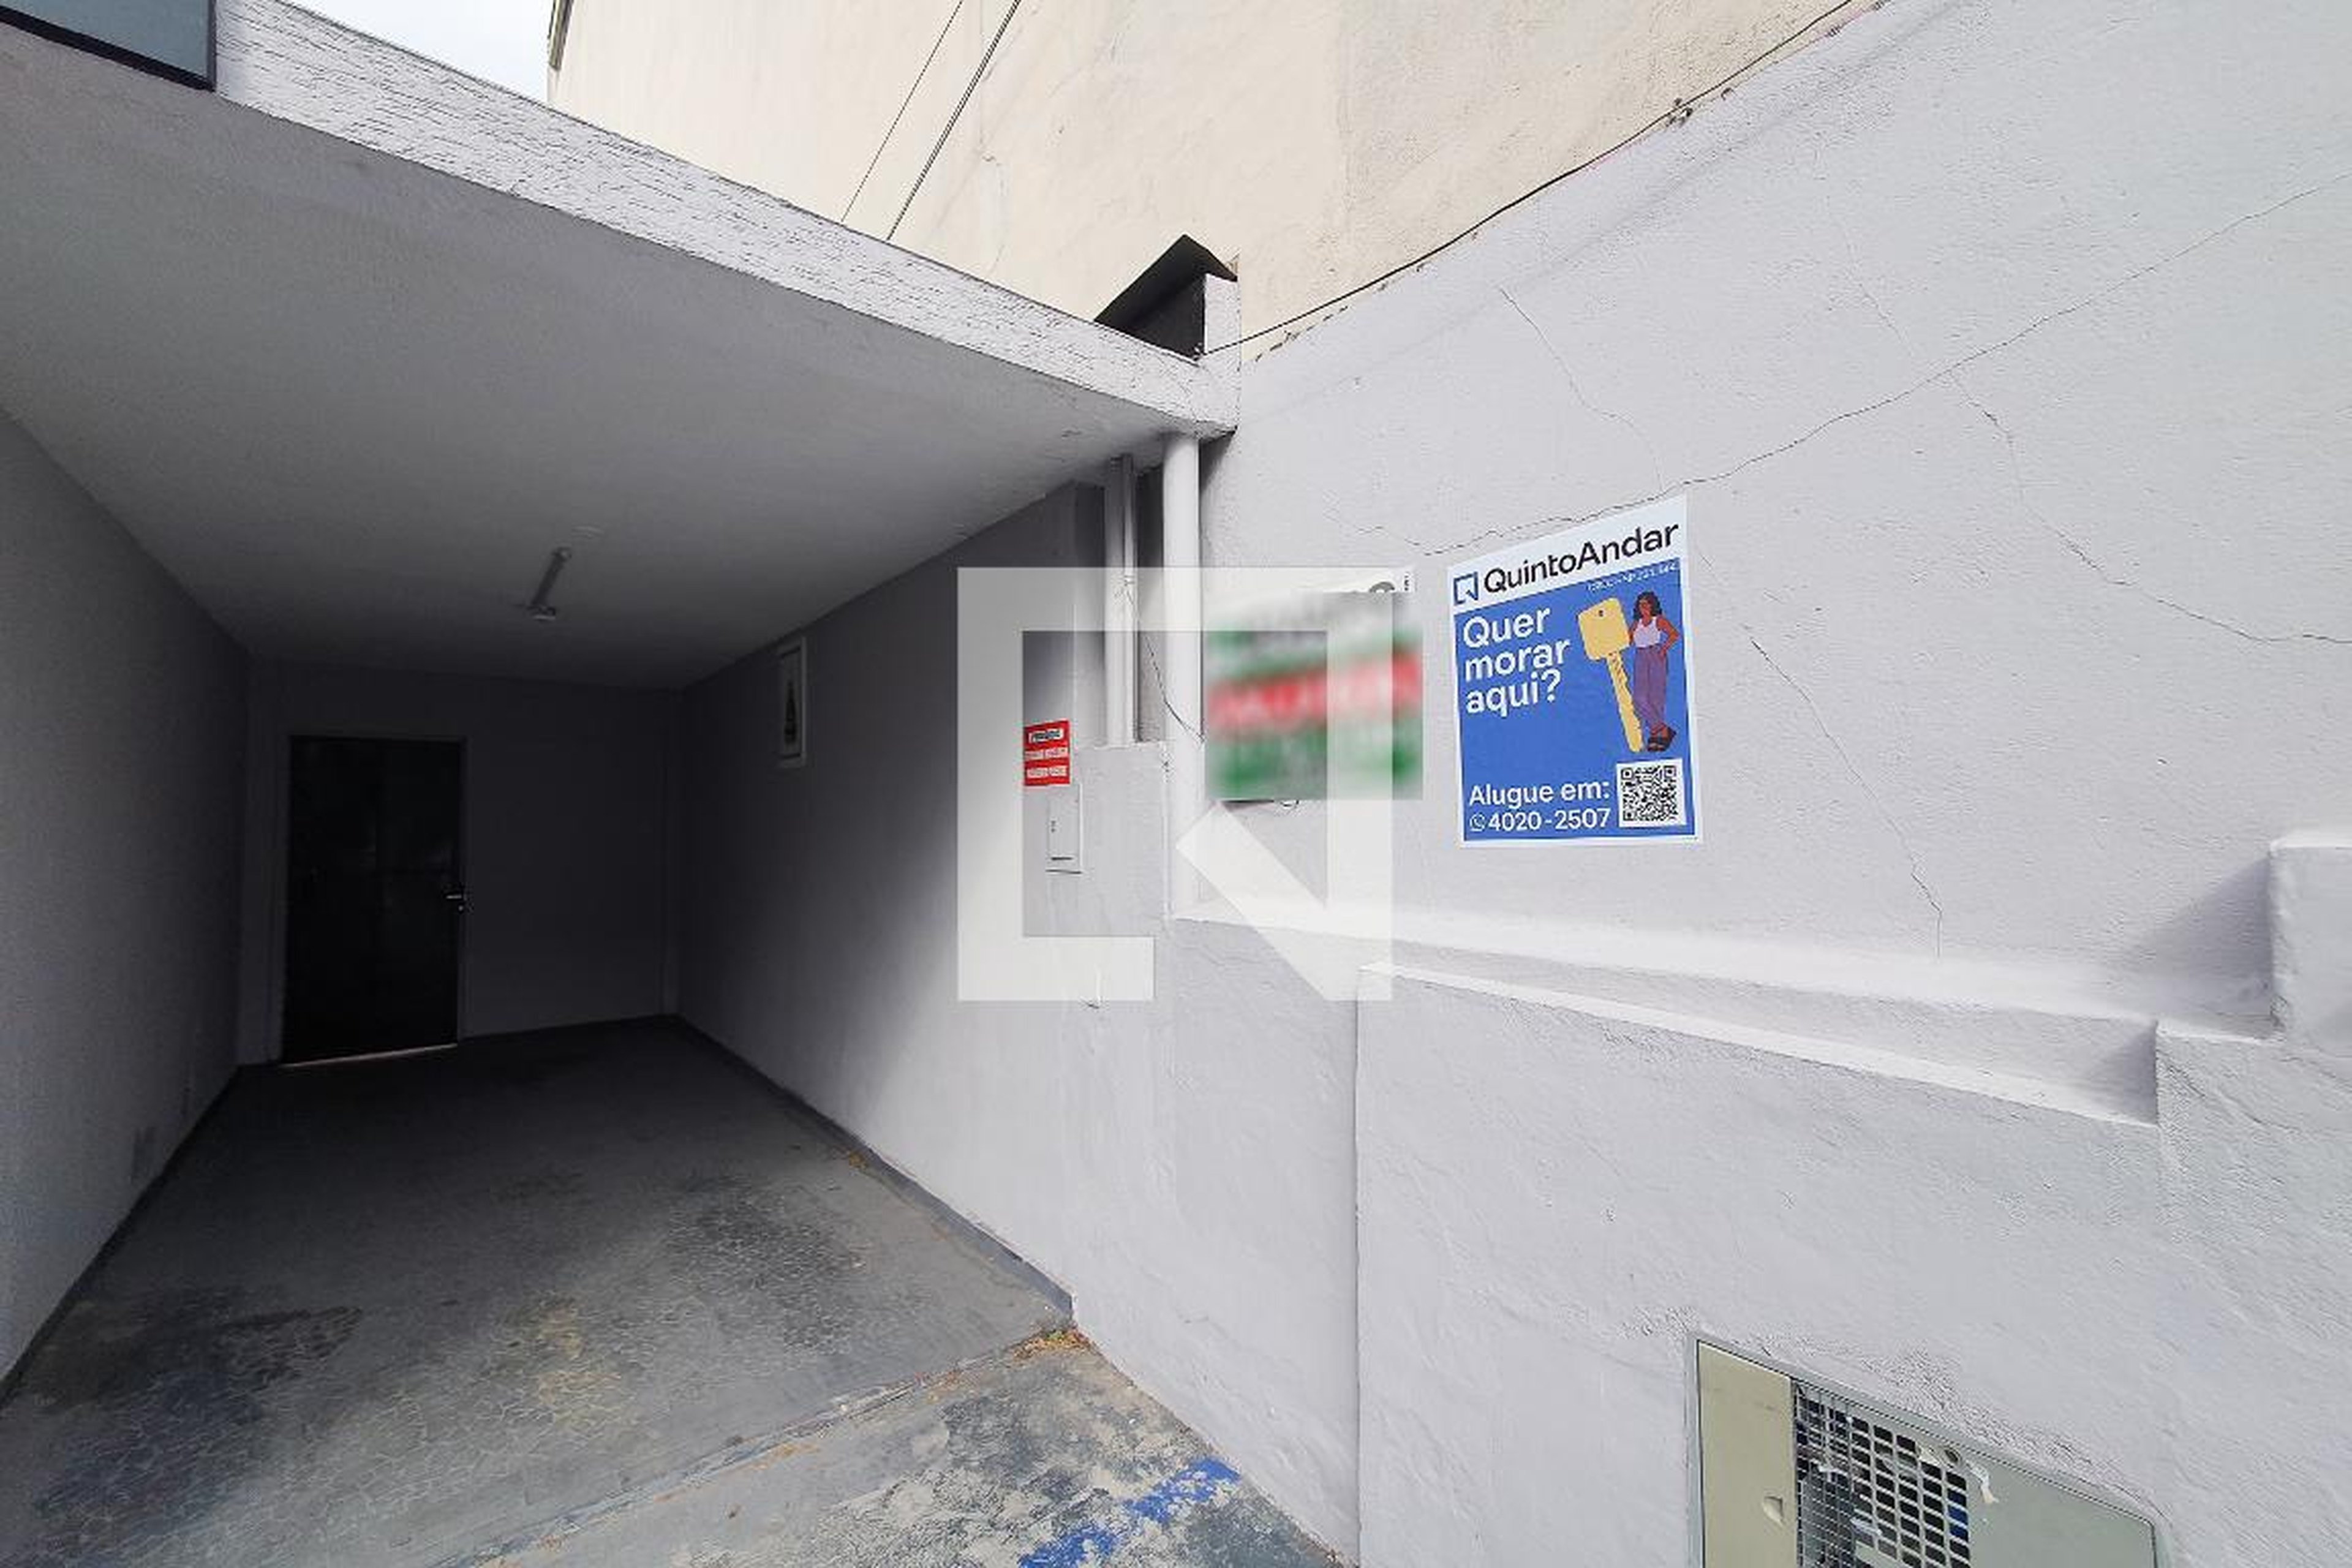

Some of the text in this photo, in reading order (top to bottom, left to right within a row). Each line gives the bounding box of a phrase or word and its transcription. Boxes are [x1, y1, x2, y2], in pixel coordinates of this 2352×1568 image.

[1484, 523, 1679, 594] QuintoAndar
[1464, 608, 1550, 648] Quer
[1465, 638, 1570, 682] morar
[1466, 669, 1561, 717] aqui?
[1469, 782, 1610, 809] Alugue em:
